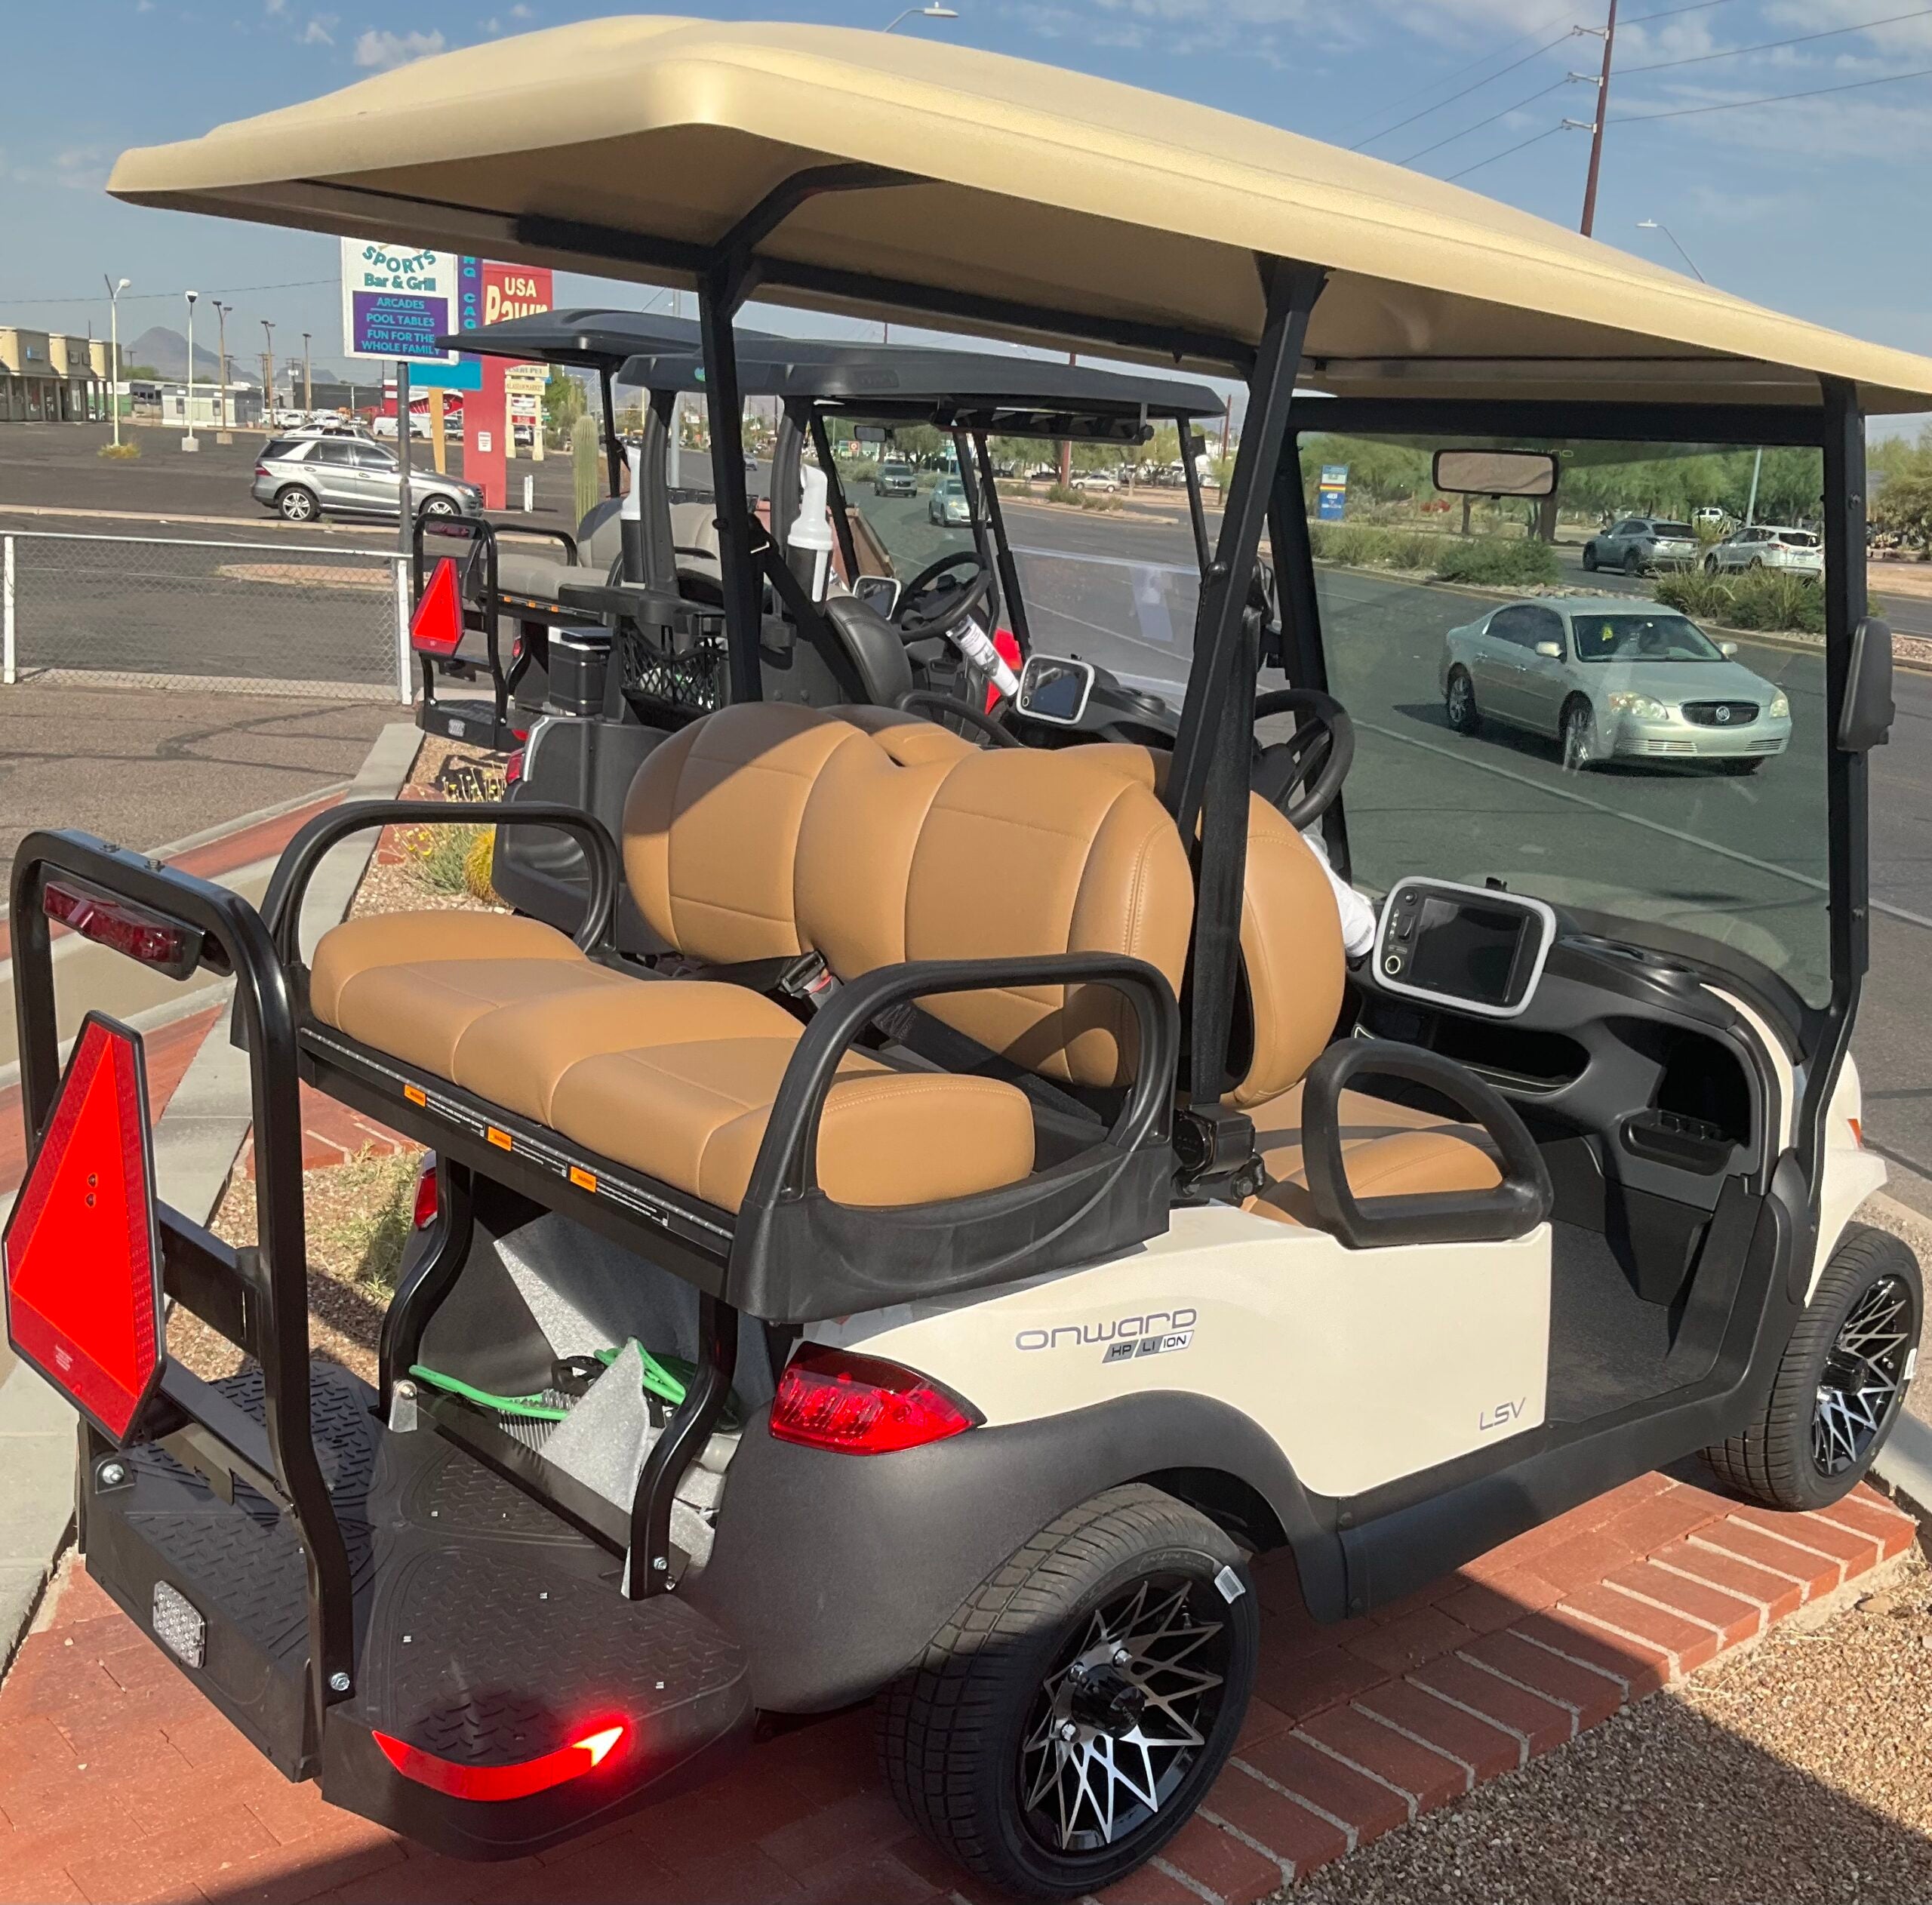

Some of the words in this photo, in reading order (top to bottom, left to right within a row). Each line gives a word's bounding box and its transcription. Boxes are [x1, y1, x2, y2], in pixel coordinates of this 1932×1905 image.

[362, 245, 436, 273] SPORTS
[364, 272, 389, 288] Bar
[392, 275, 405, 289] &
[407, 276, 436, 291] Grill
[504, 276, 537, 297] USA
[377, 297, 425, 309] ARCADES
[366, 313, 395, 324] POOL
[397, 315, 435, 327] TABLES
[367, 329, 389, 339] FUN
[392, 331, 412, 341] FOR
[414, 333, 435, 343] THE
[361, 340, 400, 352] WHOLE
[402, 343, 440, 355] FAMILY
[1112, 1344, 1131, 1357] HP
[1143, 1340, 1155, 1352] LI
[1163, 1334, 1187, 1348] ION
[1479, 1396, 1526, 1430] LSV
